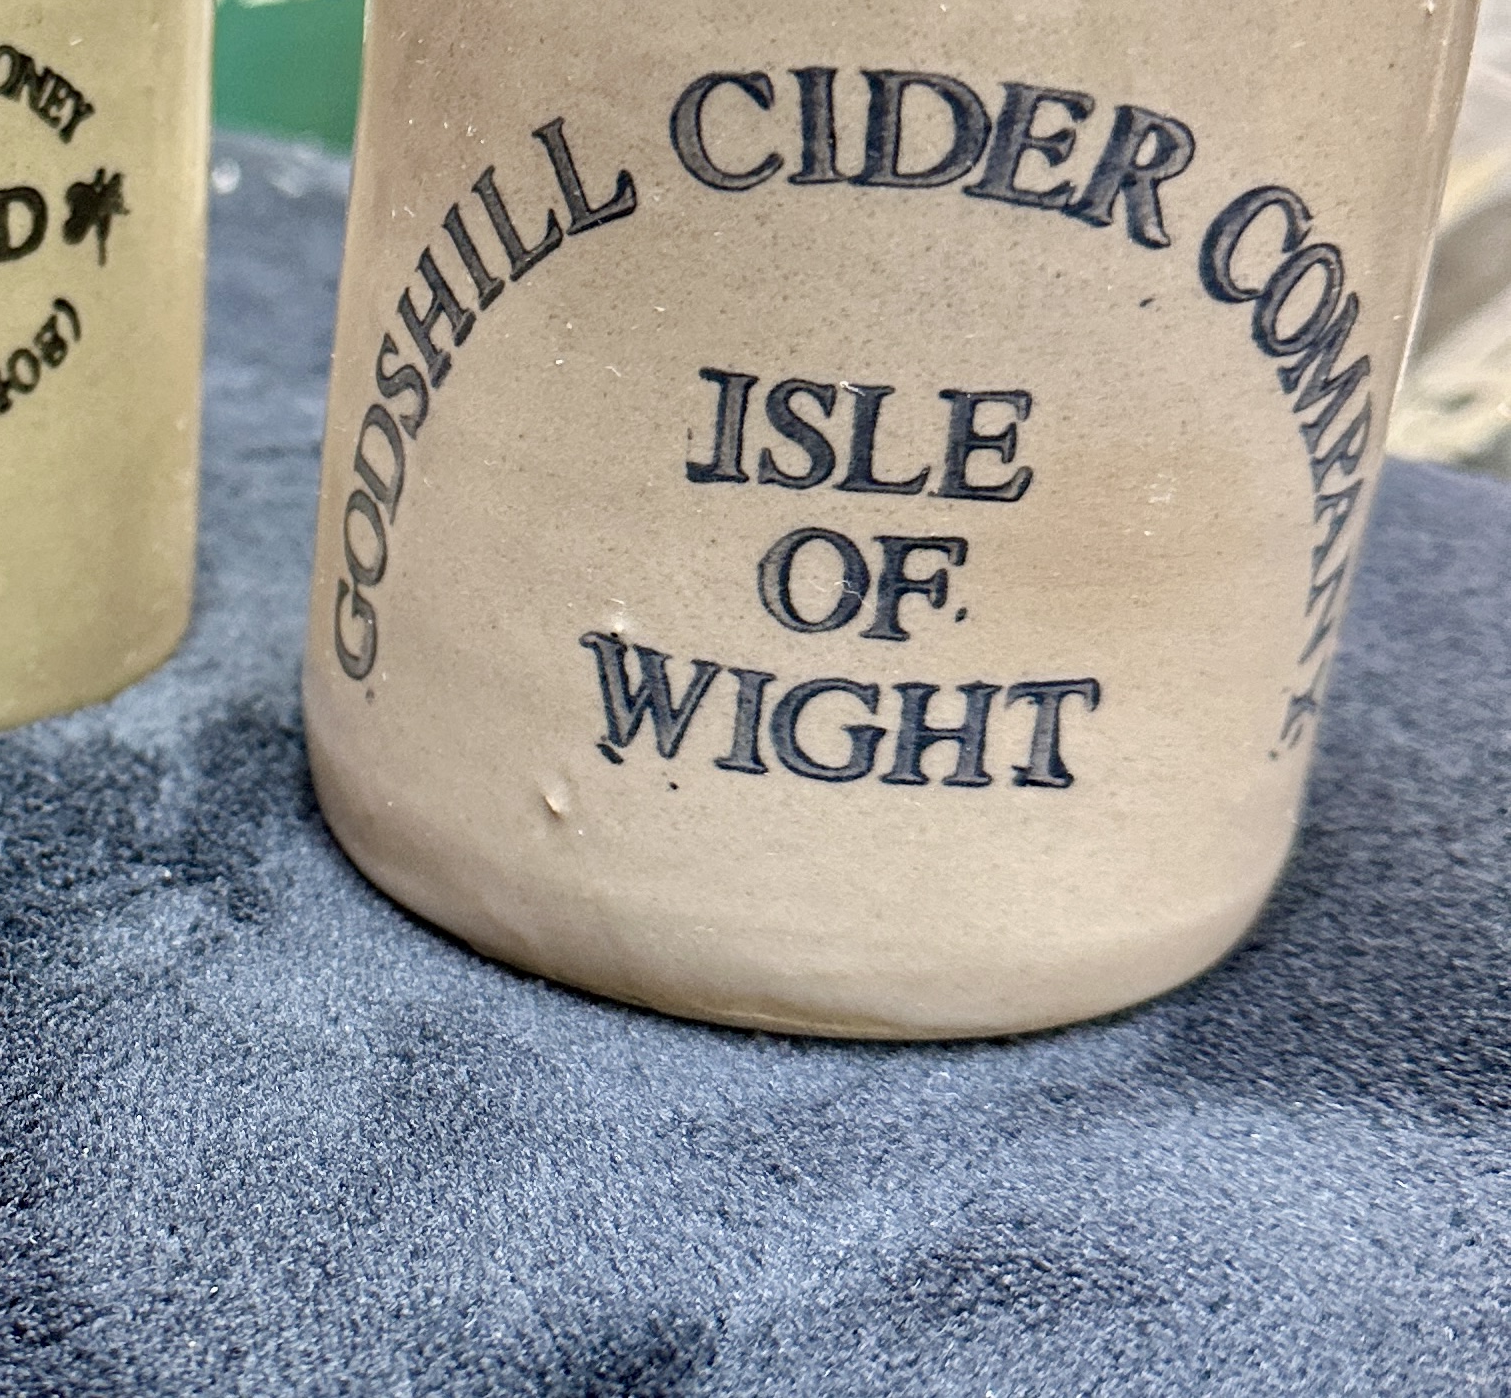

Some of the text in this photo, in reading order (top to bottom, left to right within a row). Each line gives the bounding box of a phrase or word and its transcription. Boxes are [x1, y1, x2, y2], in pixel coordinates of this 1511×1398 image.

[333, 116, 638, 682] GODSHILL
[670, 66, 1196, 248] CIDER
[685, 368, 1034, 503] ISLE
[756, 526, 968, 641] OF
[579, 630, 1101, 789] WIGHT
